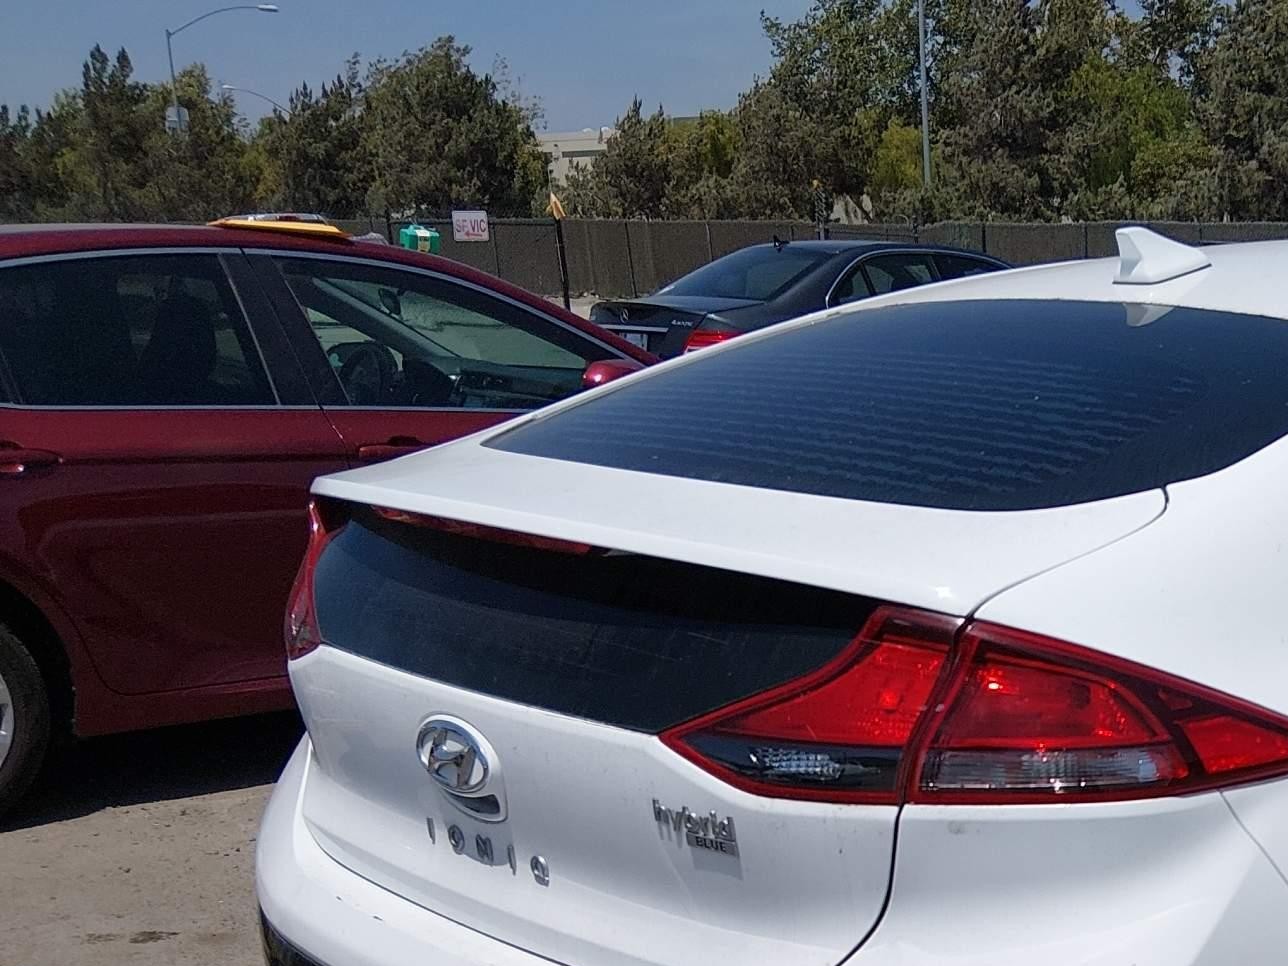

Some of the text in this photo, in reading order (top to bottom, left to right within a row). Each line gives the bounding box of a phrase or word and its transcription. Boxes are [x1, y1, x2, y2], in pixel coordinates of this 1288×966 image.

[470, 219, 486, 232] VIC
[652, 797, 737, 842] hybrid
[426, 817, 550, 888] IONIQ
[695, 836, 727, 853] BLUE
